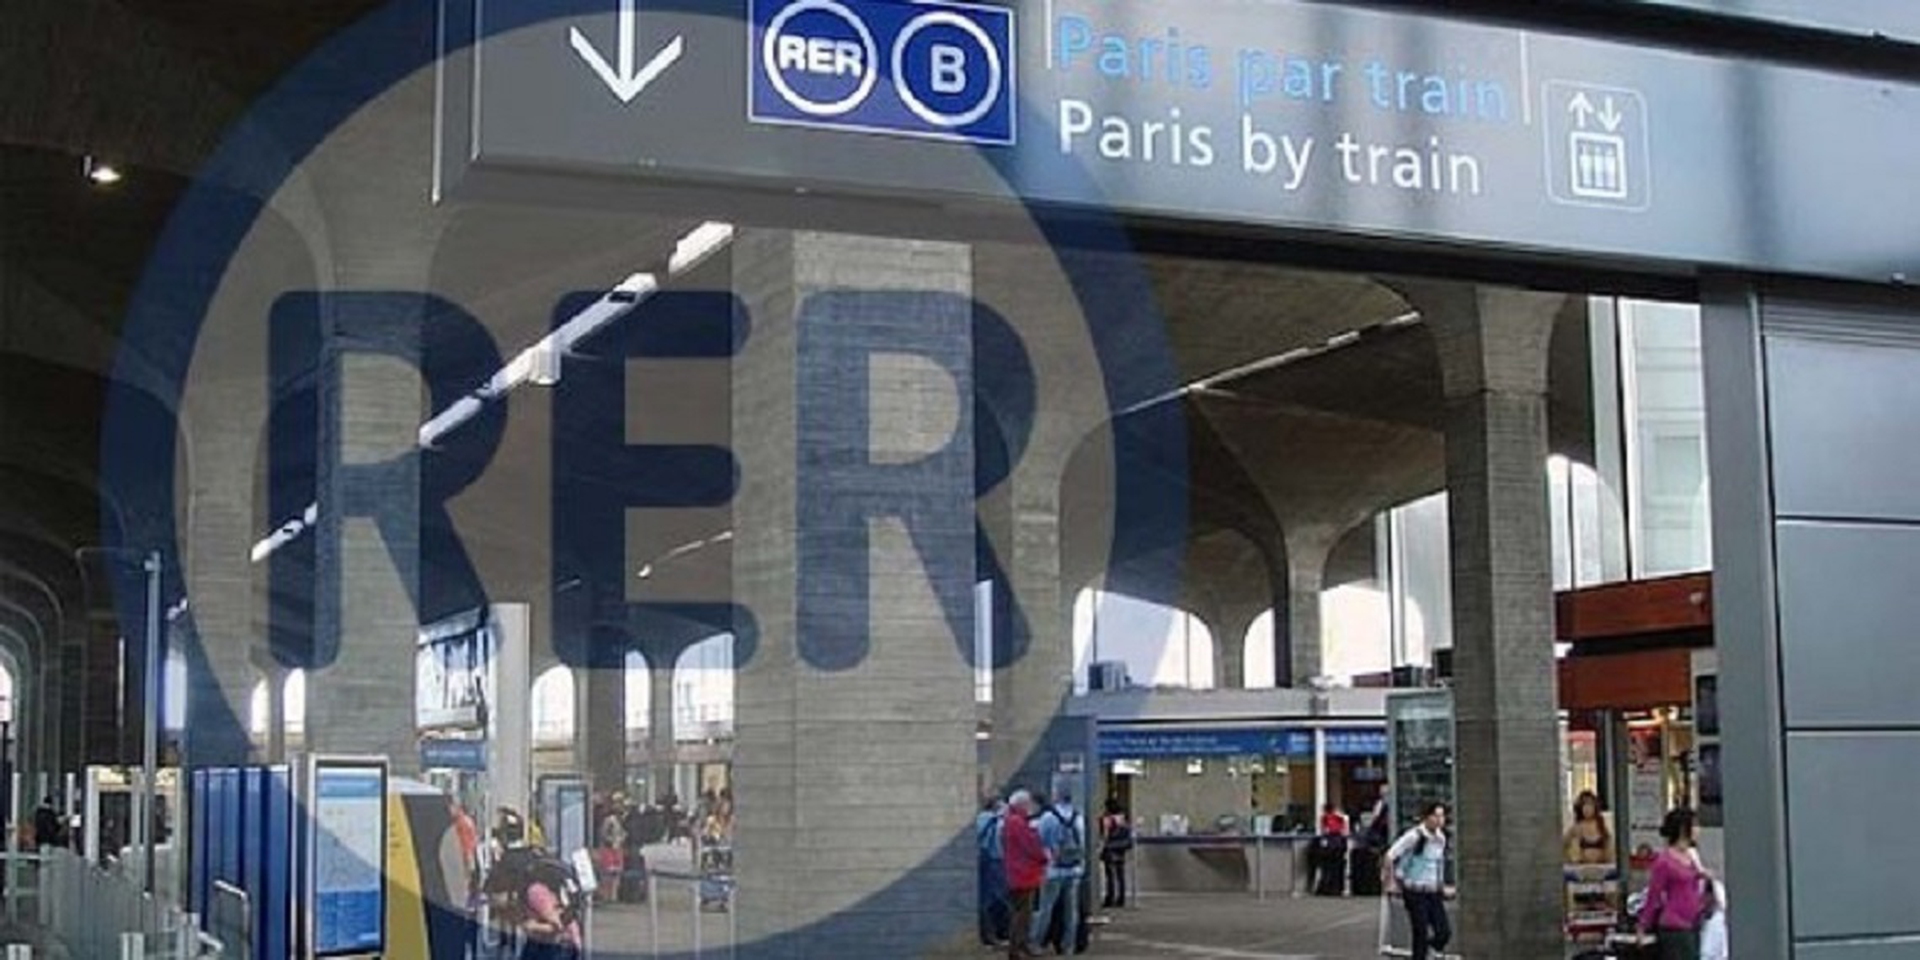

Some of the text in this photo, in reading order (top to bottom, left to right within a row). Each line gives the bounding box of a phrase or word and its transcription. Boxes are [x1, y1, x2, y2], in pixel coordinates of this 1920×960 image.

[777, 34, 864, 78] RER
[930, 43, 967, 94] B
[1058, 14, 1508, 121] Paris par train
[1059, 98, 1480, 194] Paris by train
